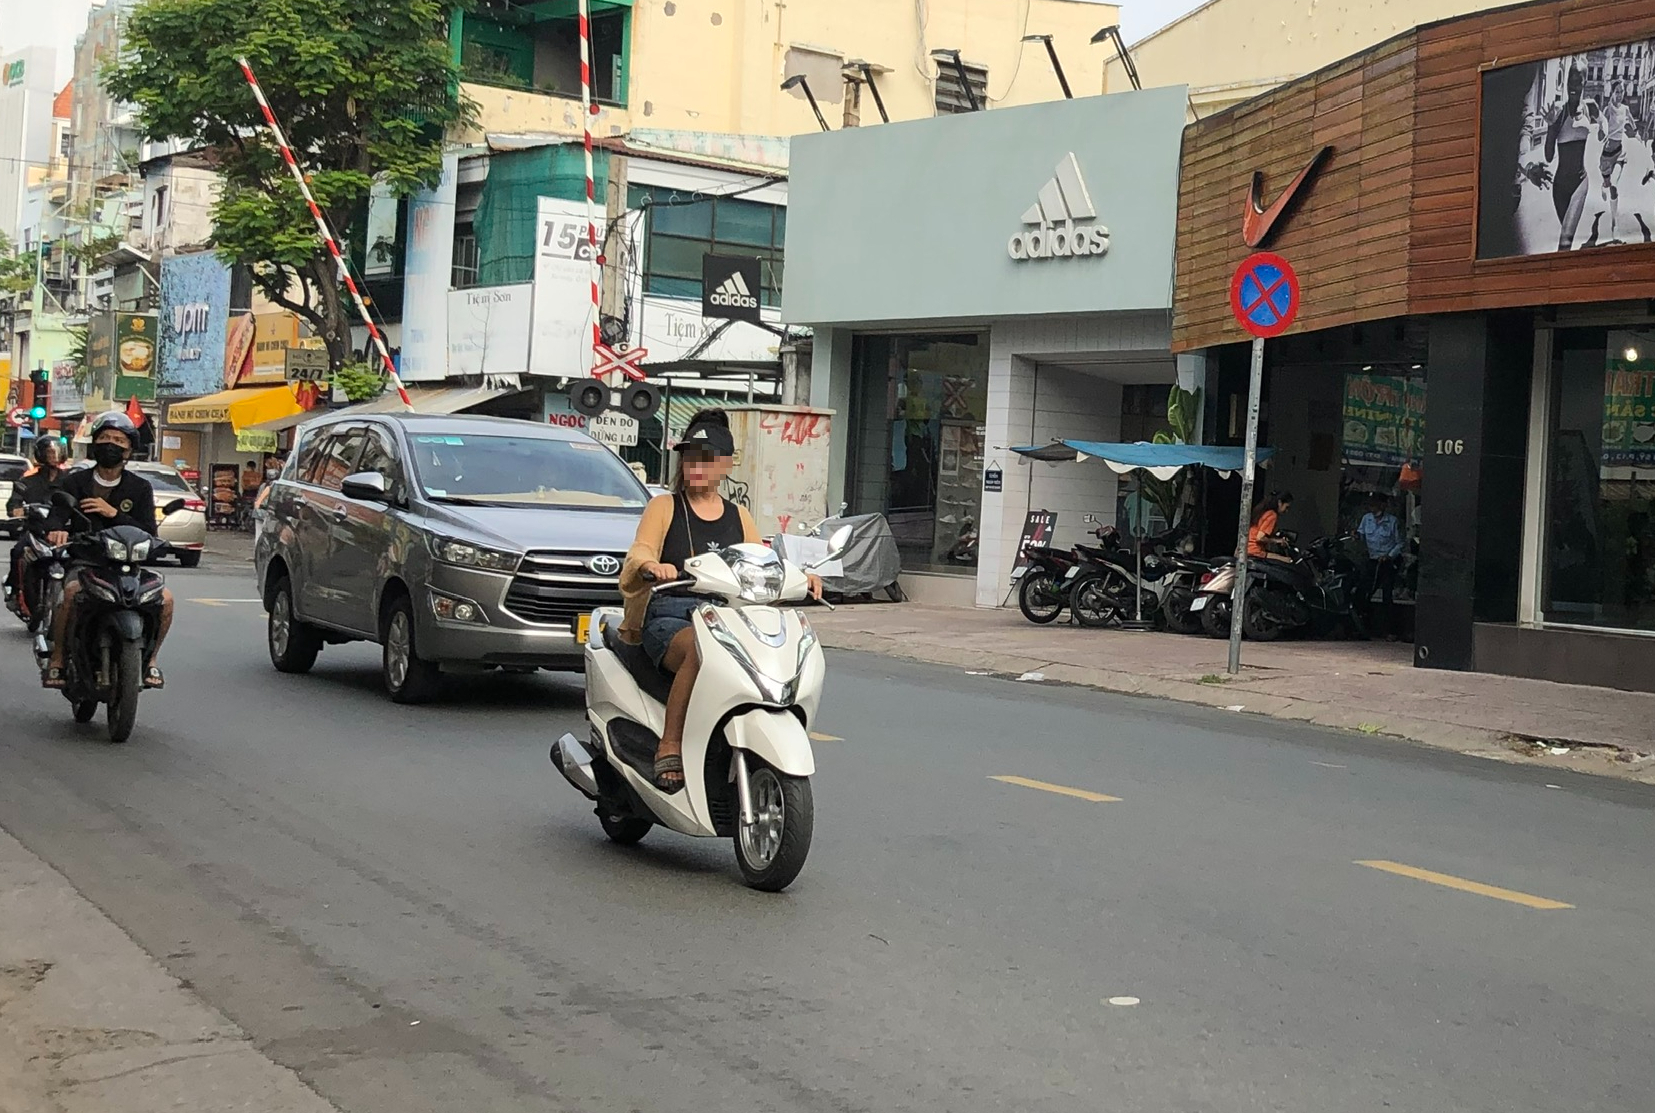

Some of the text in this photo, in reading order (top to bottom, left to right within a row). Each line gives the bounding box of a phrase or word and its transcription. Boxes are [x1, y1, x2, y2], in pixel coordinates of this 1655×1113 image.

[543, 220, 578, 250] 15
[1007, 219, 1110, 260] adidas
[710, 292, 758, 309] adidas
[664, 312, 696, 341] Tiệm
[291, 368, 323, 380] 24/7
[1435, 439, 1464, 455] 106
[1030, 515, 1051, 524] SALE
